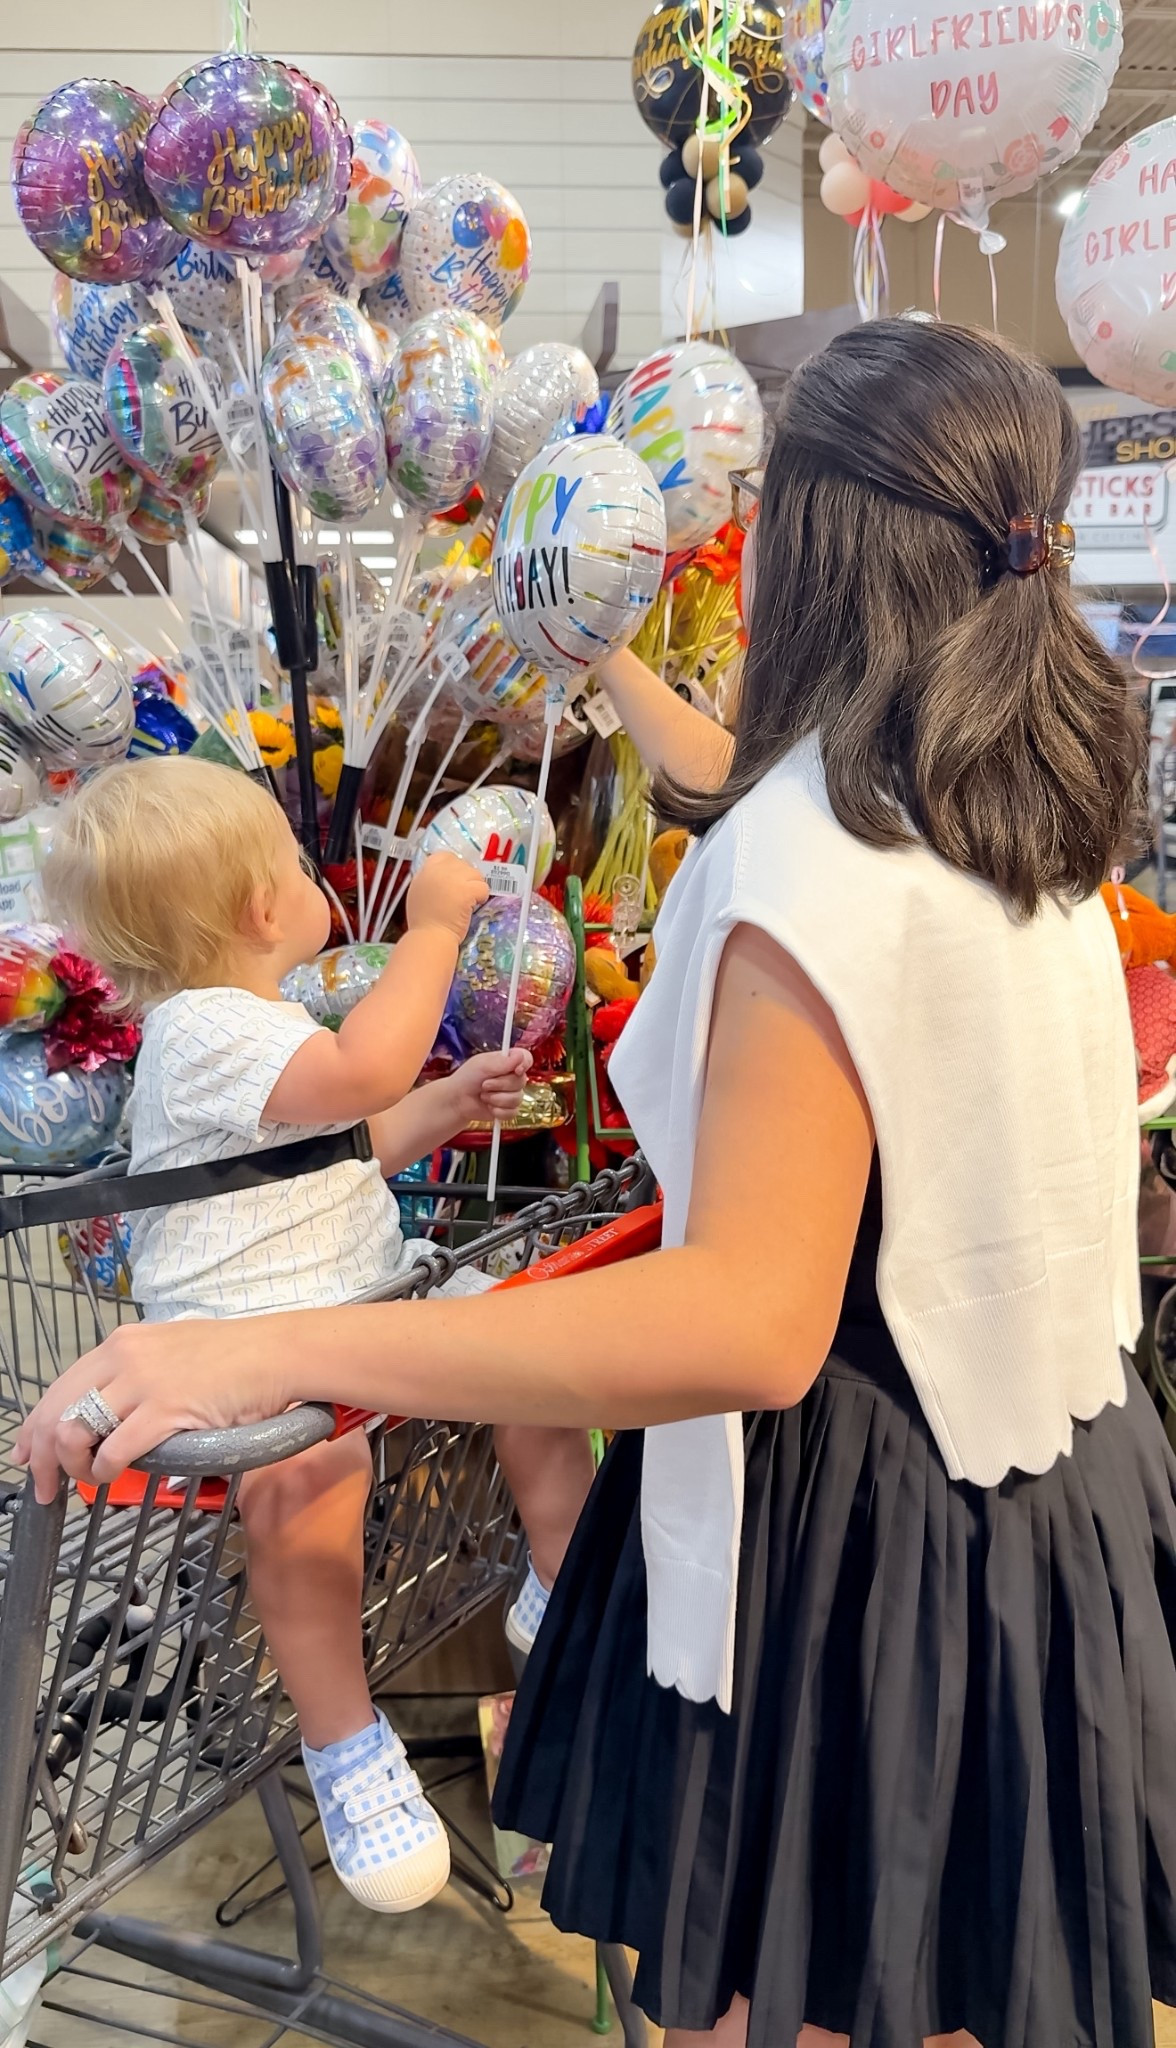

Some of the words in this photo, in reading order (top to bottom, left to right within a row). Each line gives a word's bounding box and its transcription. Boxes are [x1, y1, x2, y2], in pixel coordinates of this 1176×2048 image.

[850, 3, 1082, 72] GIRLFRIENDS
[930, 71, 998, 119] DAY
[207, 111, 312, 186] Happy
[189, 151, 336, 236] Birthday
[1116, 436, 1176, 463] SHO
